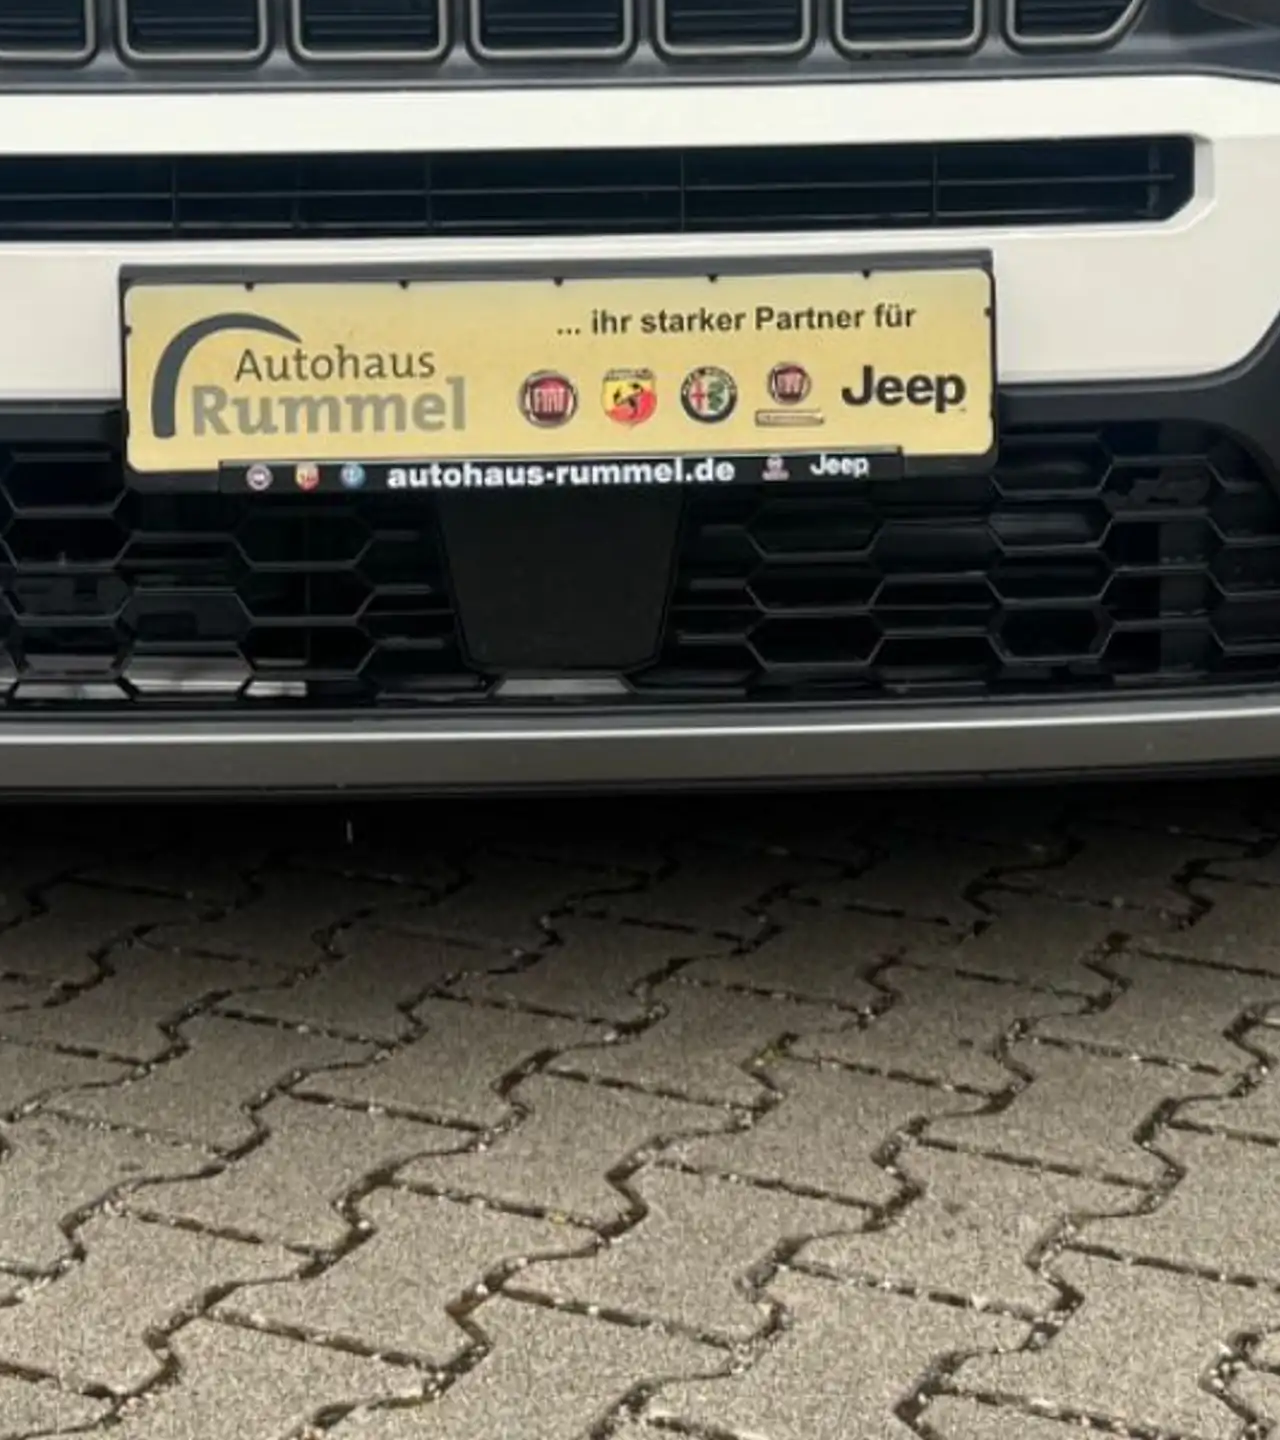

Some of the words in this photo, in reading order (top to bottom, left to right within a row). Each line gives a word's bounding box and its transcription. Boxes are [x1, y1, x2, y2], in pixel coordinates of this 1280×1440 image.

[591, 310, 631, 335] ihr
[640, 308, 746, 333] starker
[754, 306, 865, 331] Partner
[874, 304, 917, 328] für
[234, 344, 436, 383] Autohaus
[191, 375, 467, 437] Rummel
[841, 365, 967, 413] Jeep
[811, 455, 870, 477] Jeep
